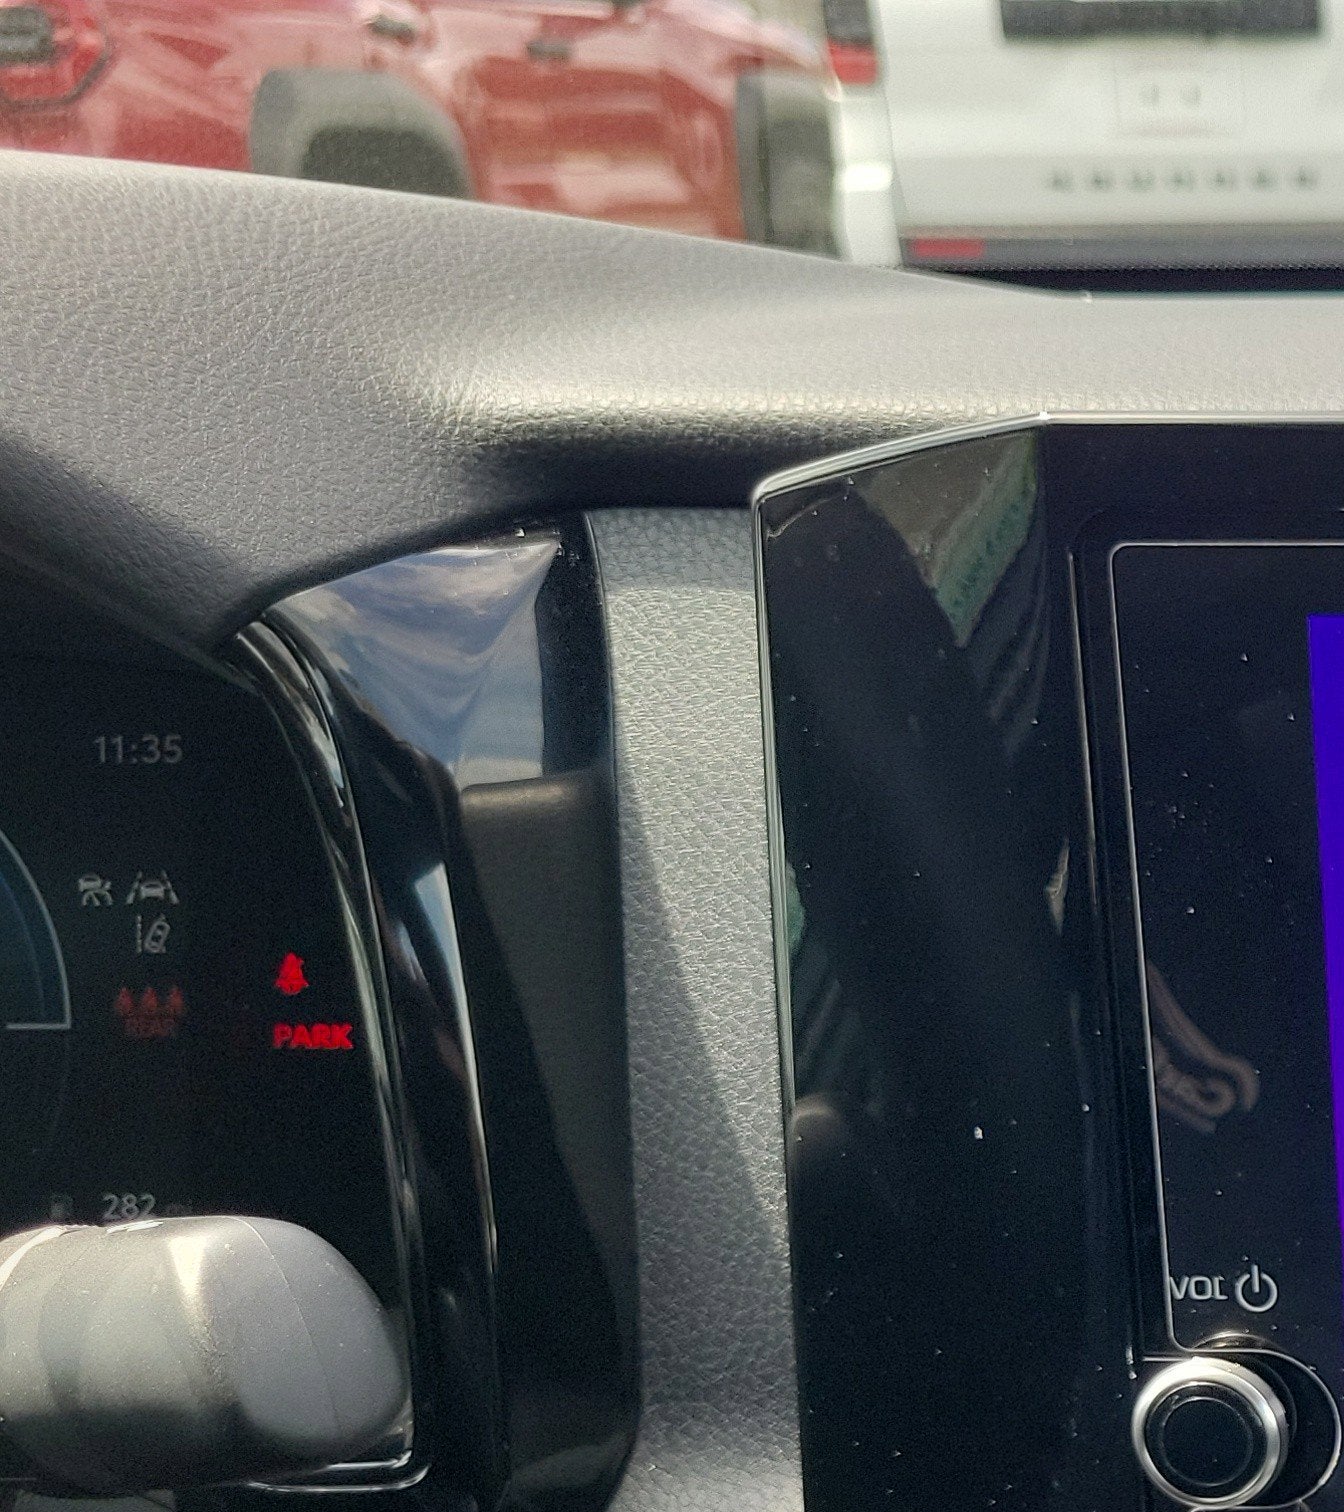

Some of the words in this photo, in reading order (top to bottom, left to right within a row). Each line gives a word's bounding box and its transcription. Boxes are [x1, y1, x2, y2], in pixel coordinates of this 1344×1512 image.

[95, 735, 183, 764] 11:35
[272, 1023, 353, 1048] PARK
[102, 1194, 157, 1219] 282
[1169, 1274, 1229, 1301] VOL
